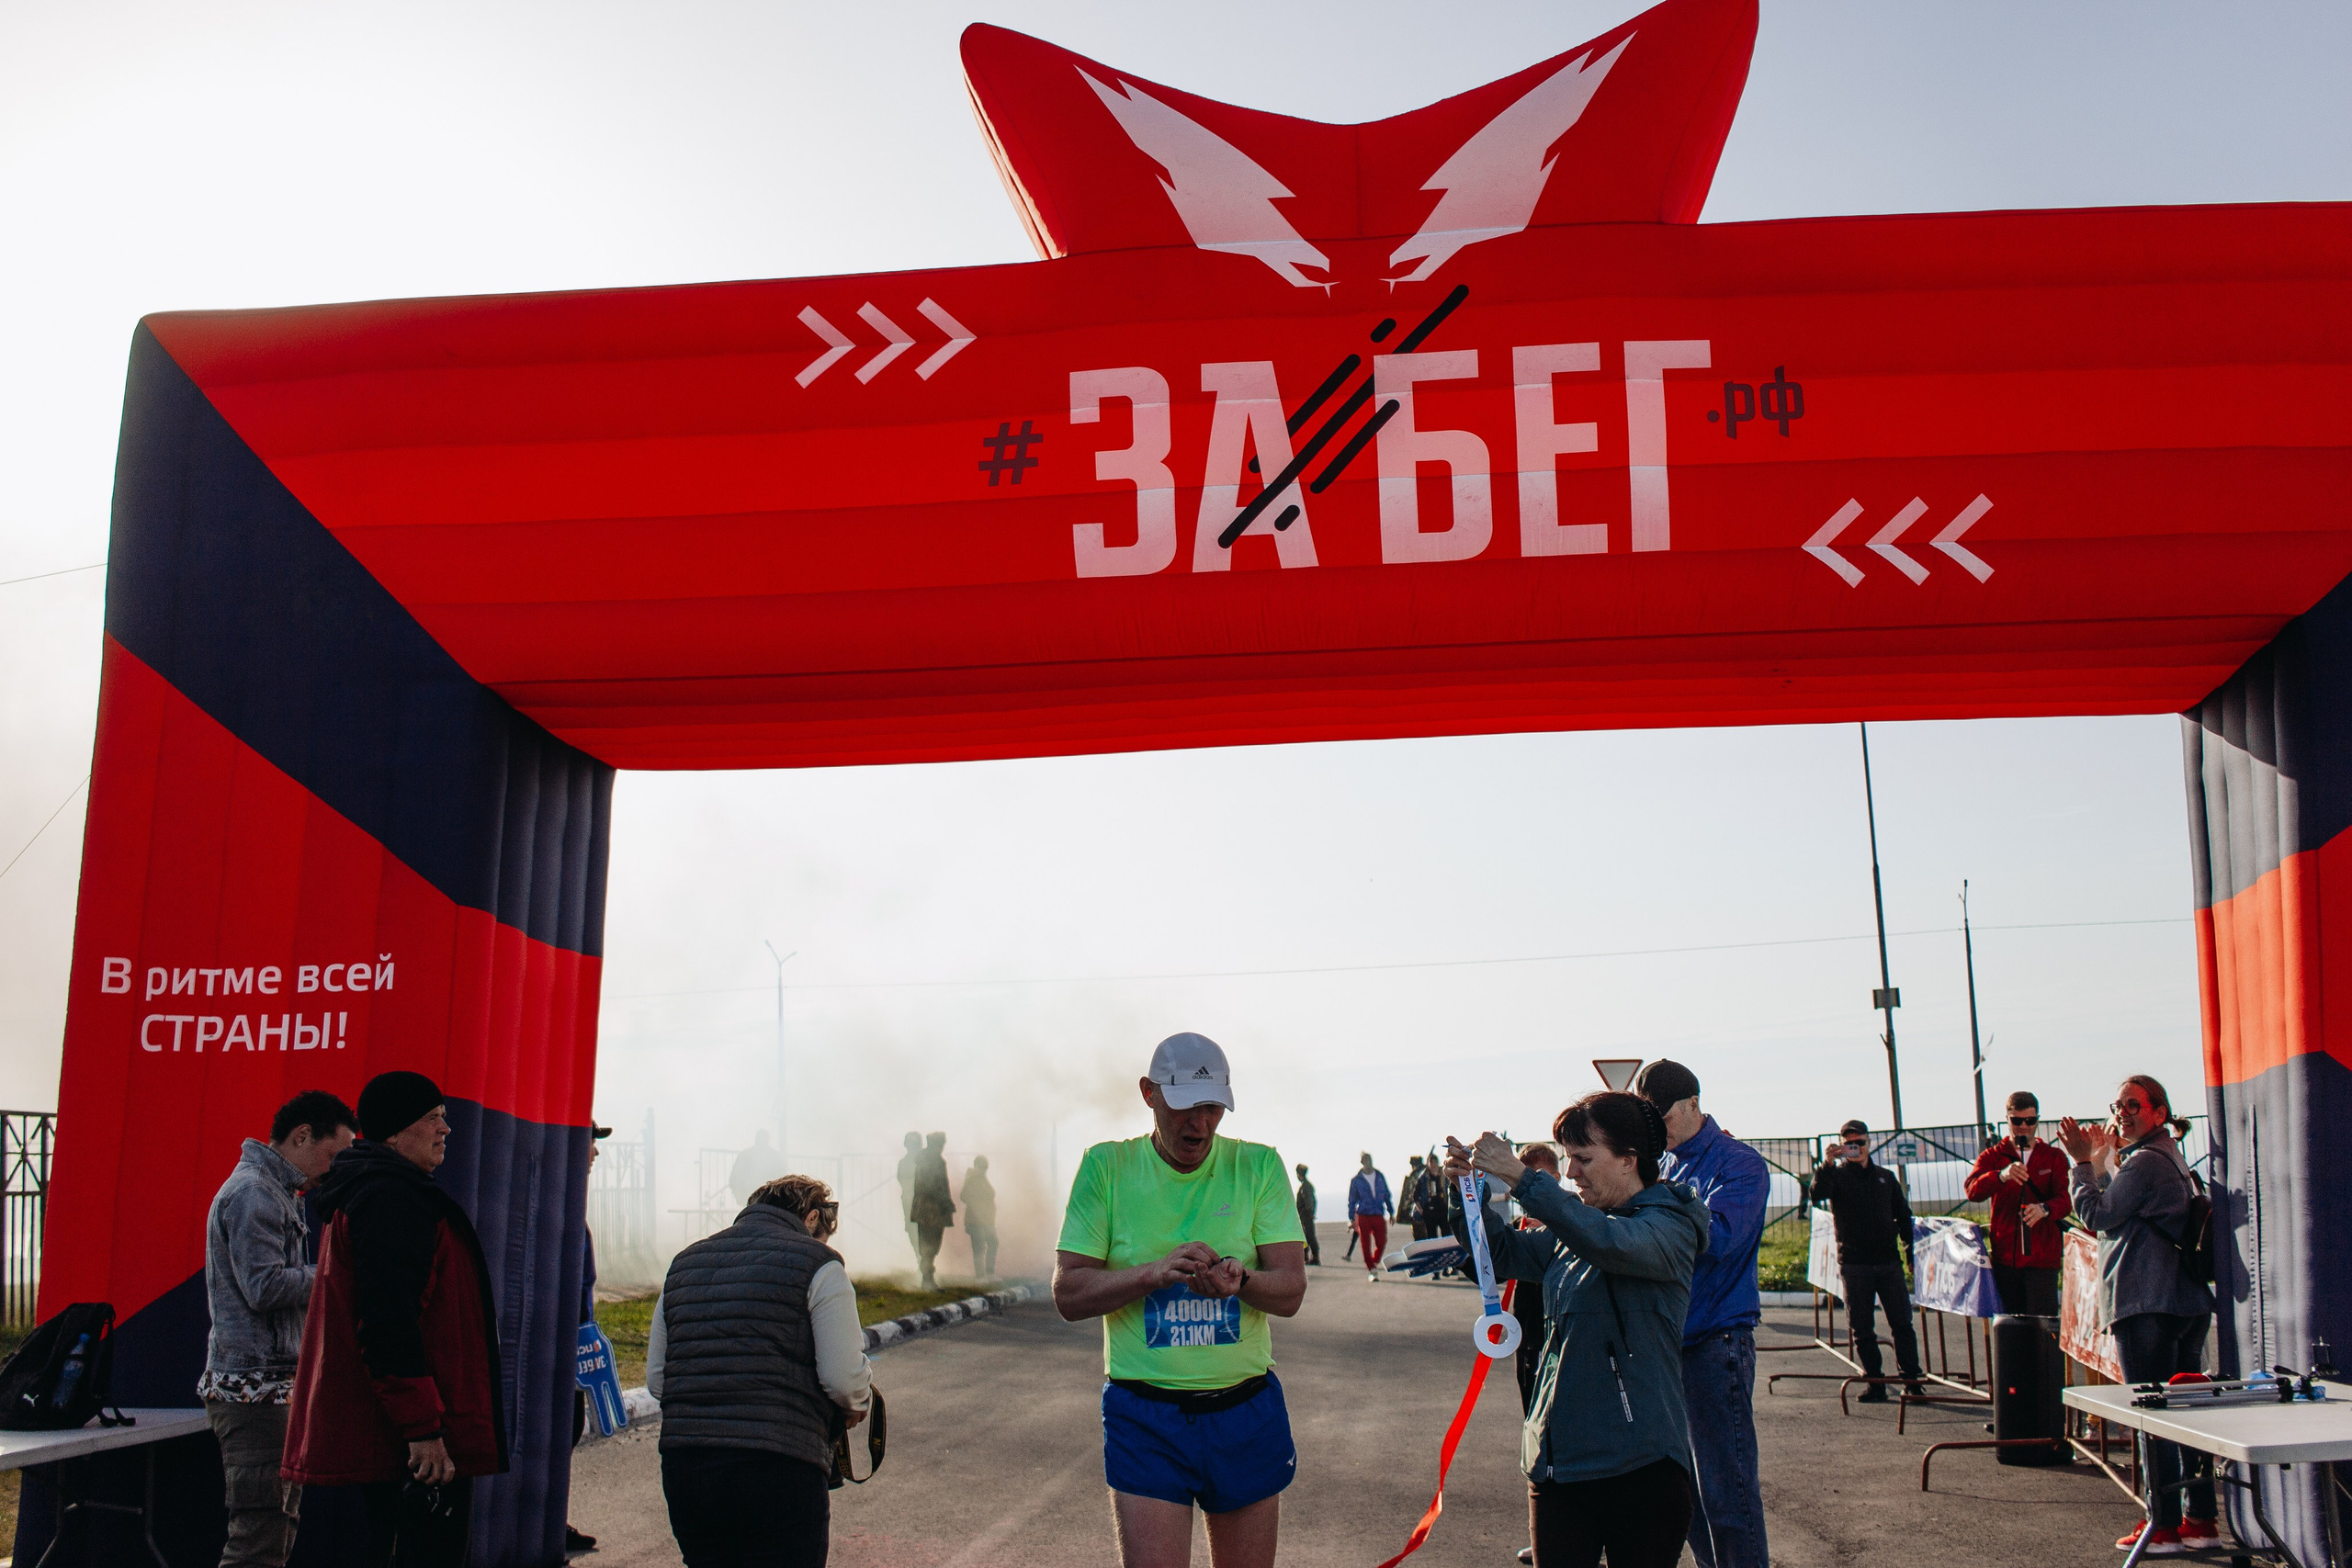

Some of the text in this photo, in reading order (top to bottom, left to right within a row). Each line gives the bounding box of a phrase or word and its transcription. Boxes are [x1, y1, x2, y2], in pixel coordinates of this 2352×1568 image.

[101, 953, 394, 1001] В ритме всей
[141, 1011, 347, 1053] СТРАНЫ!
[1464, 1177, 1473, 1192] ПСБ
[1164, 1298, 1222, 1323] 40001
[1170, 1324, 1216, 1347] 21.1KM
